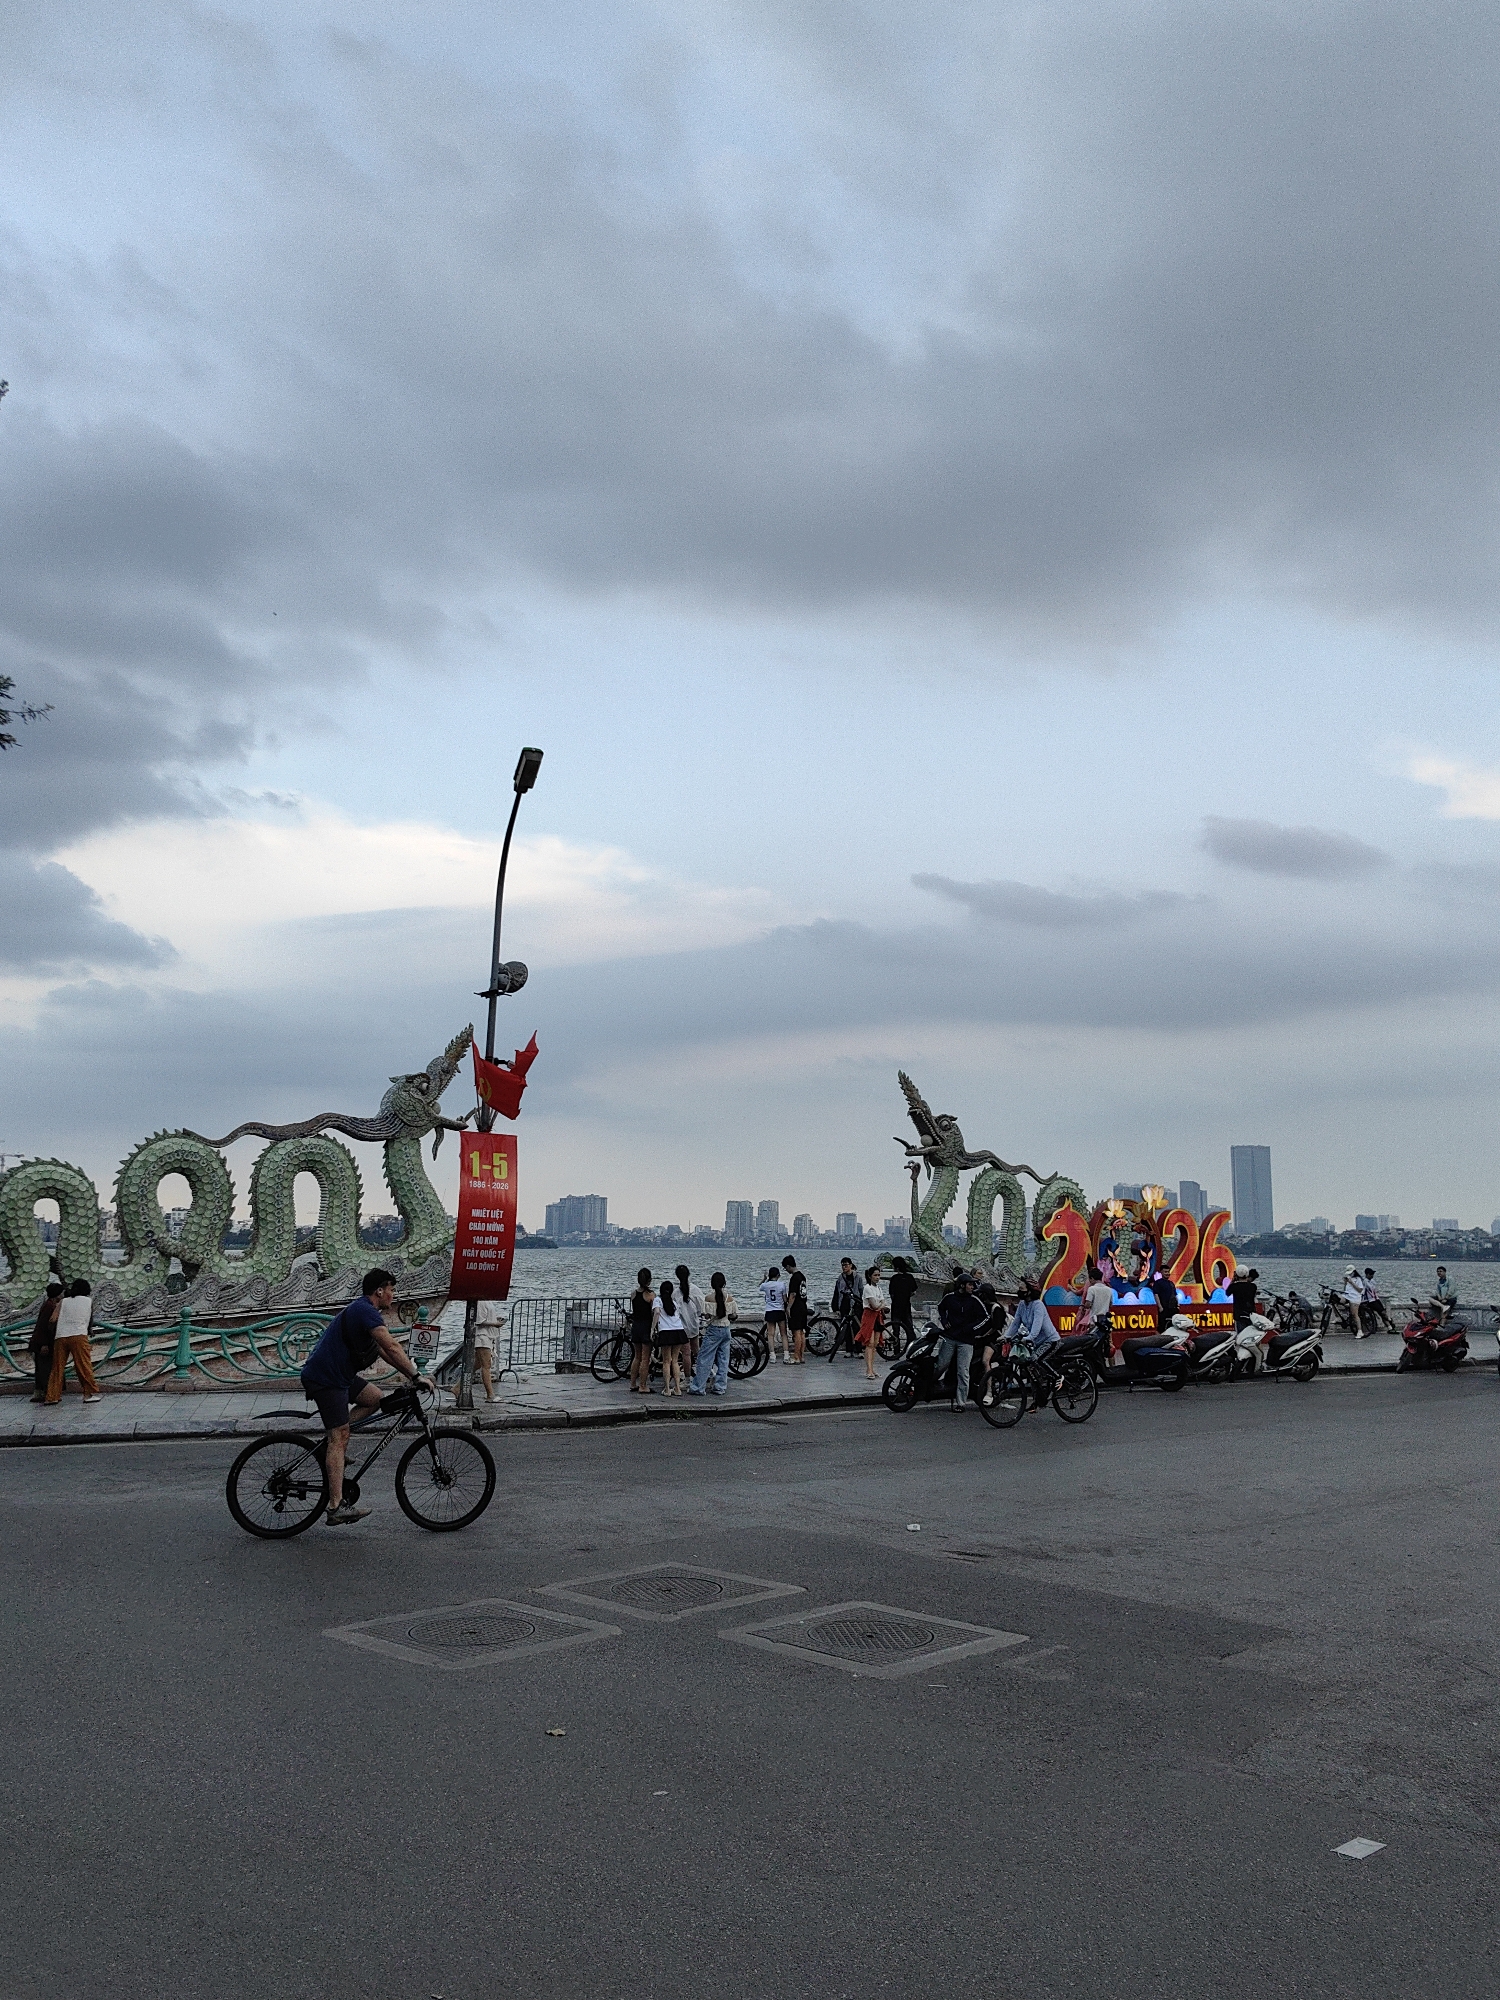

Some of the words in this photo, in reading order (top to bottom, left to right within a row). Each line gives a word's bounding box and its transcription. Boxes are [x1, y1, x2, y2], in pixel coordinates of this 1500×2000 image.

[469, 1150, 508, 1180] 1-5
[469, 1180, 486, 1189] 1886
[491, 1182, 509, 1190] 2026
[472, 1208, 490, 1219] NHIỆT
[490, 1208, 504, 1220] LIỆT
[469, 1221, 486, 1231] CHÀO
[486, 1222, 504, 1232] MỪNG
[472, 1236, 483, 1245] 140
[484, 1236, 498, 1245] NĂM
[462, 1248, 479, 1258] NGÀY
[479, 1247, 497, 1259] QUỐC
[497, 1248, 507, 1259] TẾ
[466, 1261, 478, 1270] LAO
[478, 1261, 496, 1272] ĐỘNG
[770, 1289, 776, 1301] 5
[1129, 1309, 1155, 1329] CỦA
